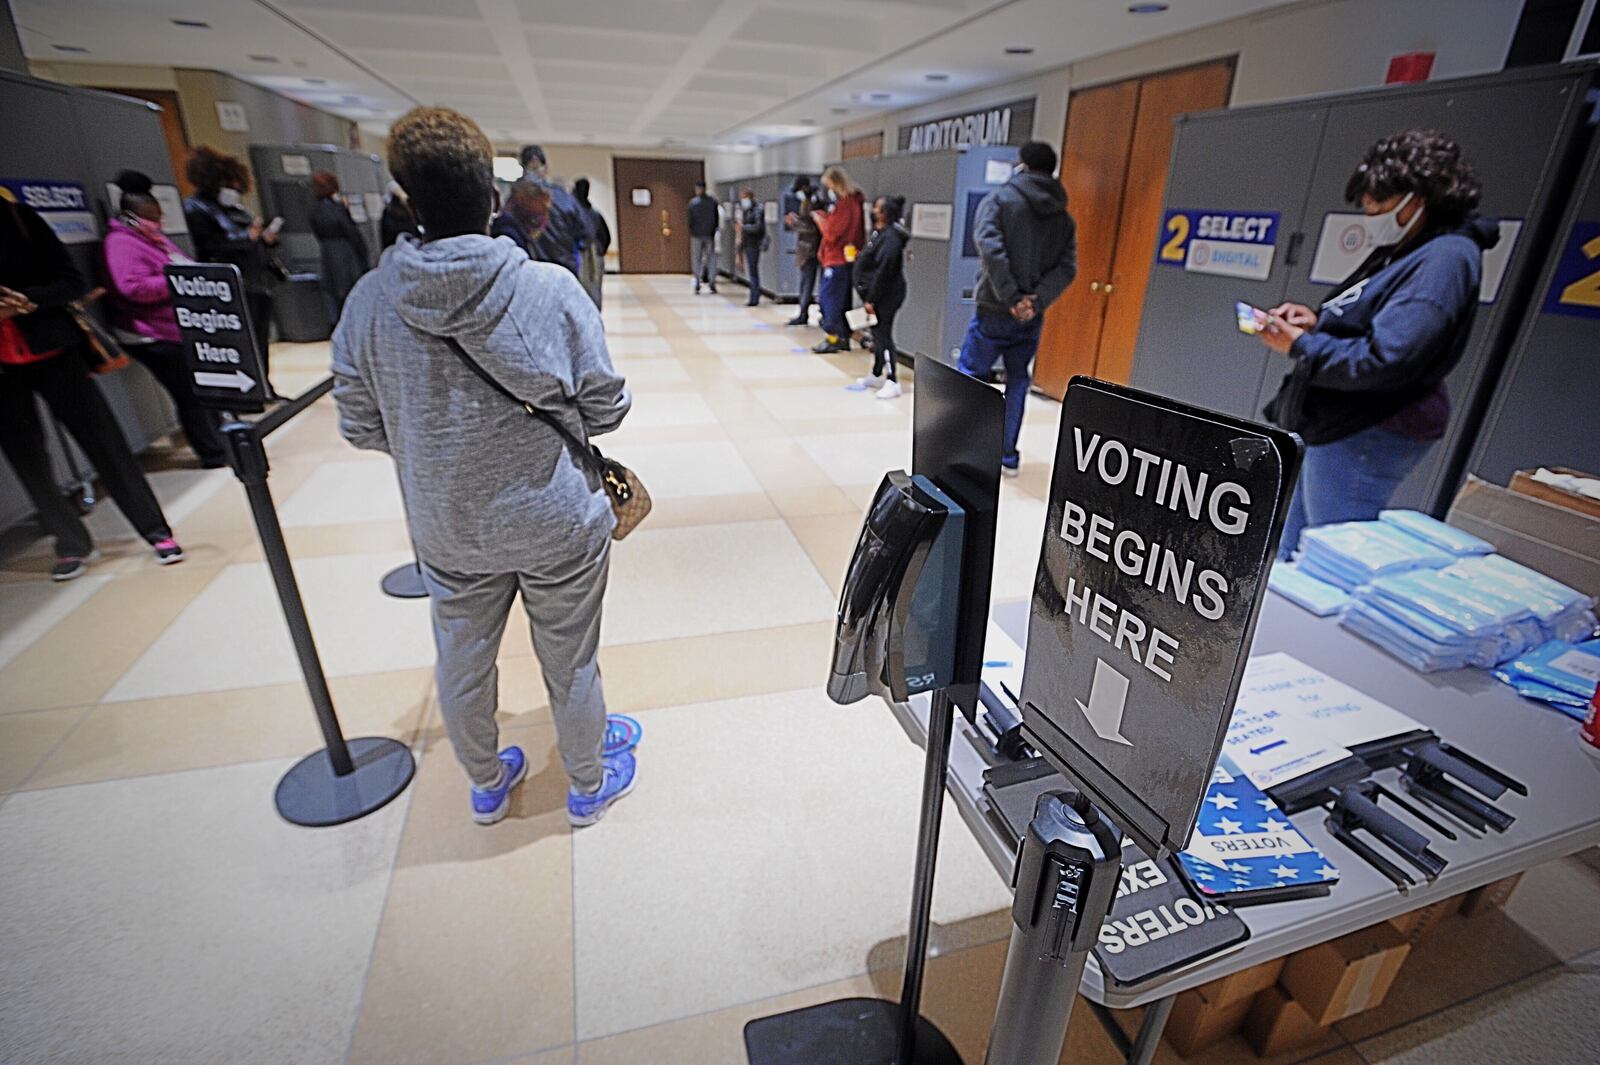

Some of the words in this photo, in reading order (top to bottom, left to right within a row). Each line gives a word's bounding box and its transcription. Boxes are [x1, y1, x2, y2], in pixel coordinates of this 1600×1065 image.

[909, 108, 1011, 153] AUDITORIUM
[1162, 214, 1190, 261] 2
[1197, 215, 1273, 242] SELECT
[169, 274, 233, 302] Voting
[175, 307, 242, 333] Begins
[195, 341, 240, 364] Here
[1073, 426, 1251, 536] VOTING
[1060, 500, 1229, 621] BEGINS
[1063, 577, 1180, 683] HERE
[1210, 835, 1293, 853] VOTERS
[1116, 858, 1168, 899] EX
